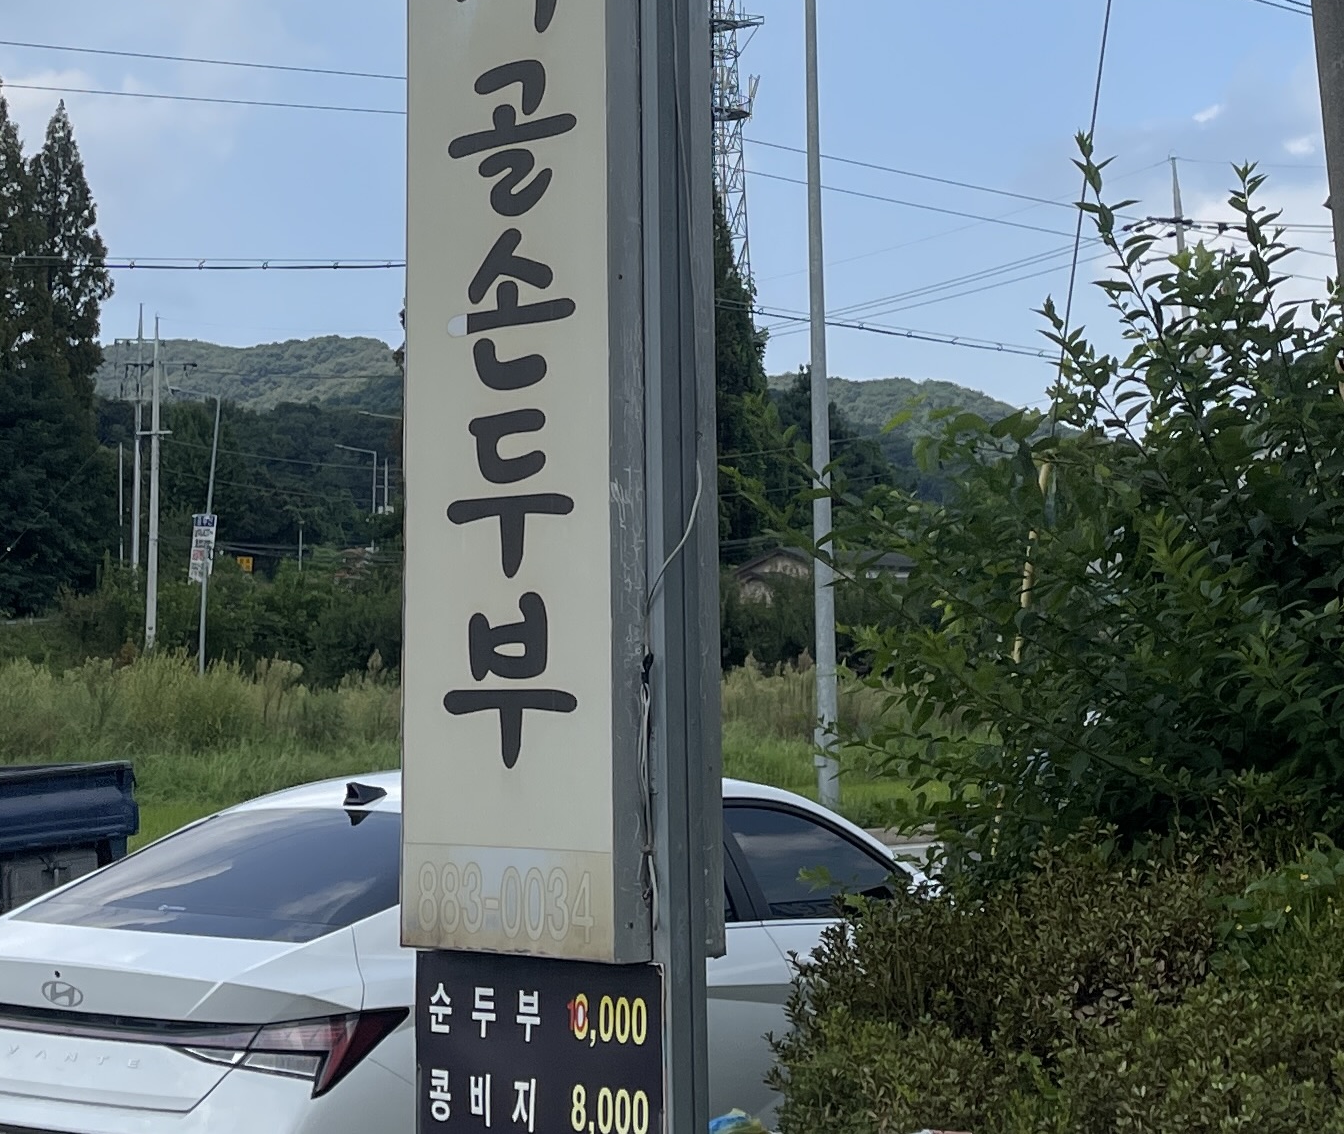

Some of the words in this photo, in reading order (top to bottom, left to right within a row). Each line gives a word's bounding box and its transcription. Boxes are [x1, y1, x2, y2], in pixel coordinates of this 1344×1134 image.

[418, 860, 595, 945] 883-0034
[428, 981, 542, 1043] 순두부
[429, 1068, 537, 1134] 콩비지
[570, 1083, 650, 1134] 8,000
